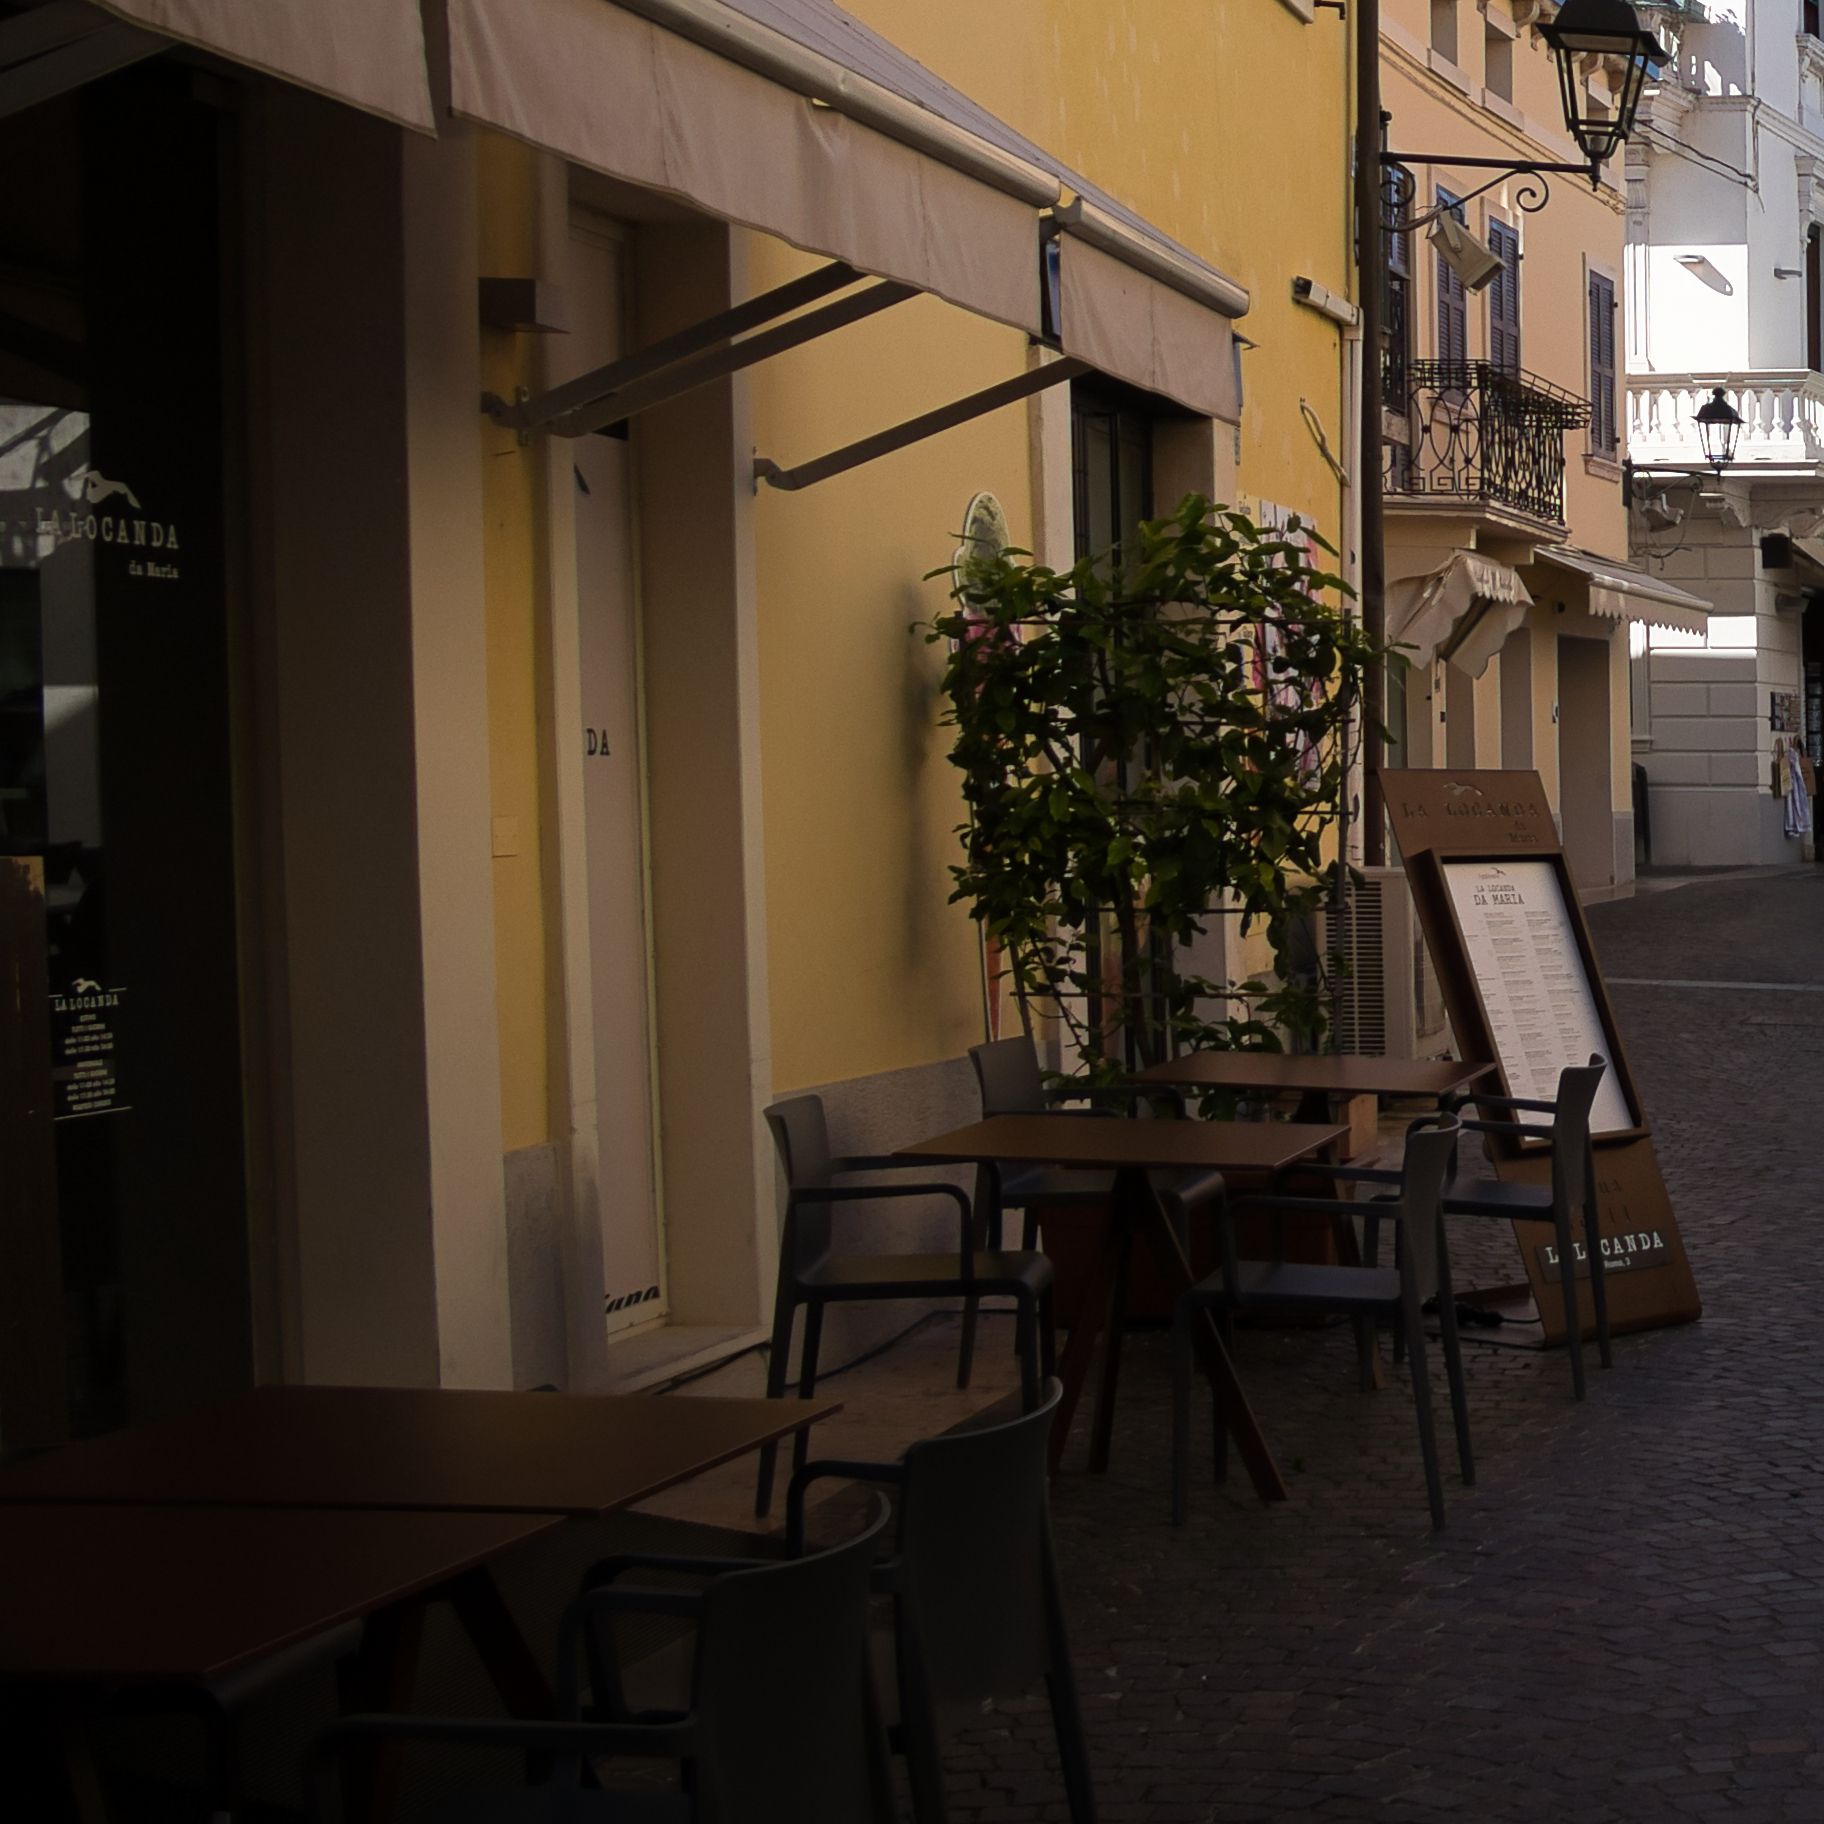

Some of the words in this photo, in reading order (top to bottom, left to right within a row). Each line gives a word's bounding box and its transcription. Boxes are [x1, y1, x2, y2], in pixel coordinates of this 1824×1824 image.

[35, 506, 63, 536] LA
[69, 511, 180, 551] LOCANDA
[128, 560, 143, 576] da
[146, 561, 180, 580] Maria
[1445, 801, 1540, 817] LOCANDA
[1473, 894, 1489, 906] DA
[1491, 893, 1526, 906] MARIA
[68, 993, 120, 1011] LOCANDA
[1573, 1230, 1664, 1260] LCANDA
